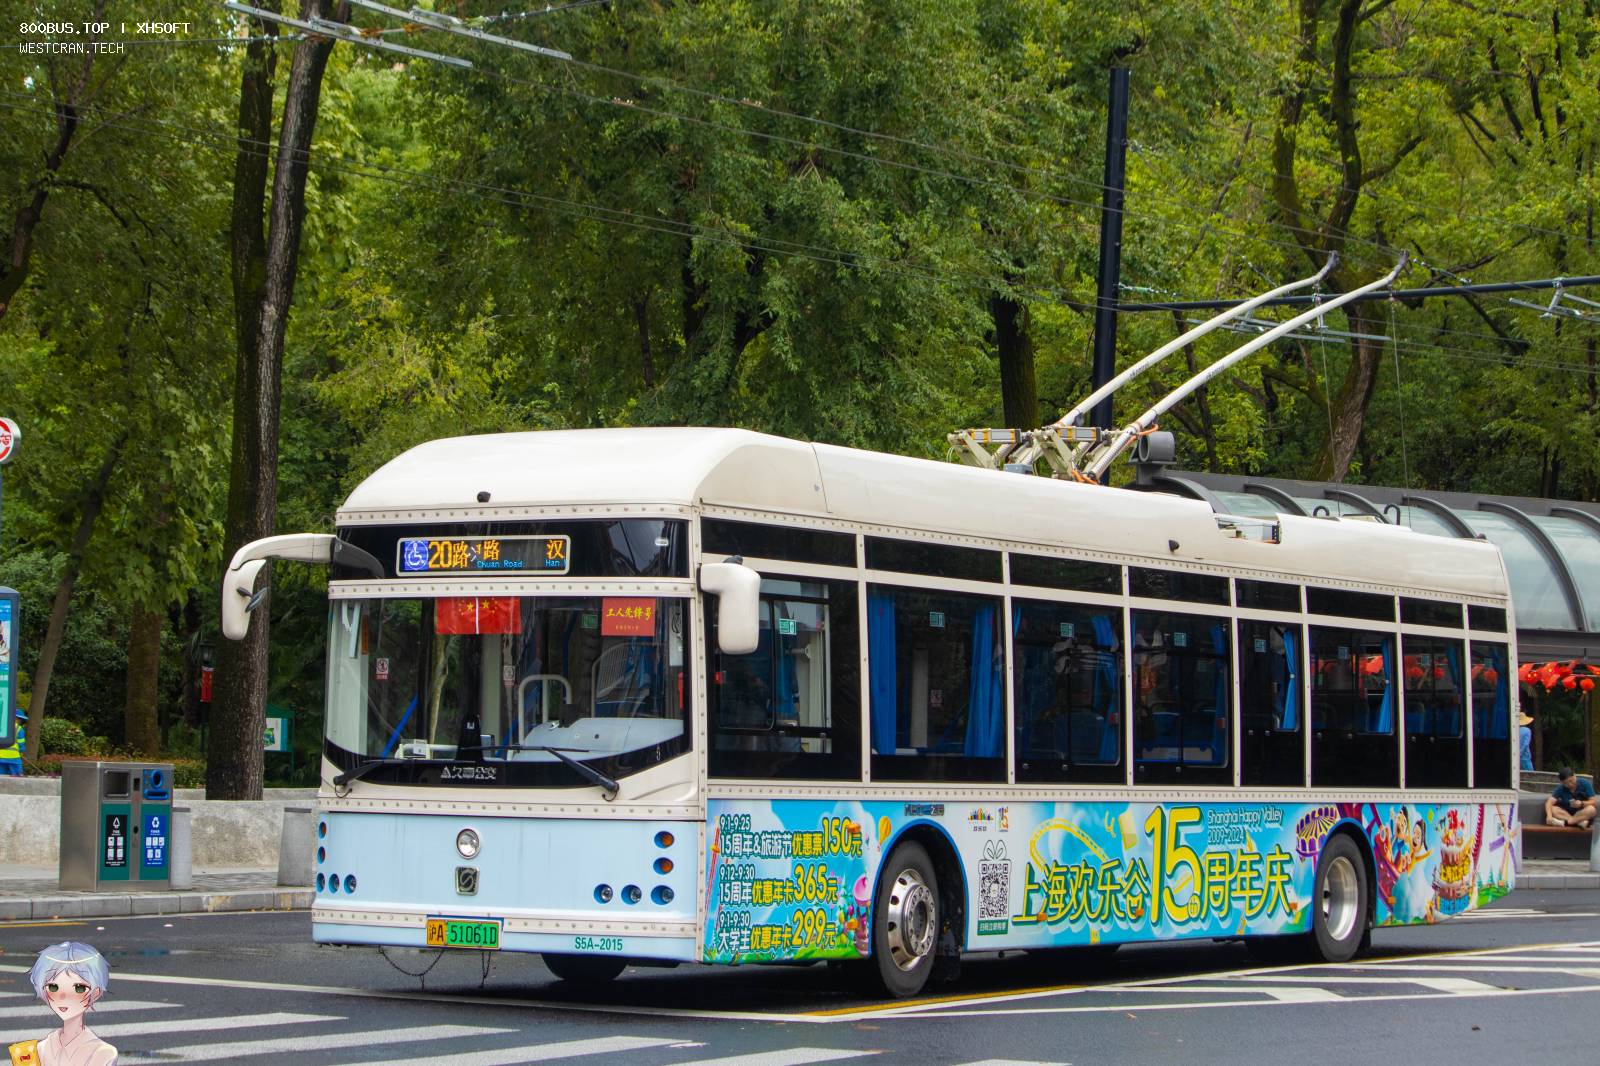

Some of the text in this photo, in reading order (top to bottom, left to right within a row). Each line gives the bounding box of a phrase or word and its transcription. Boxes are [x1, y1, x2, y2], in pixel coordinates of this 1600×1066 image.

[428, 540, 469, 569] 20路
[546, 539, 564, 560] 汉
[503, 559, 523, 568] Road
[545, 559, 560, 567] Han
[450, 924, 497, 945] 51061D
[574, 936, 623, 951] S5A-2015
